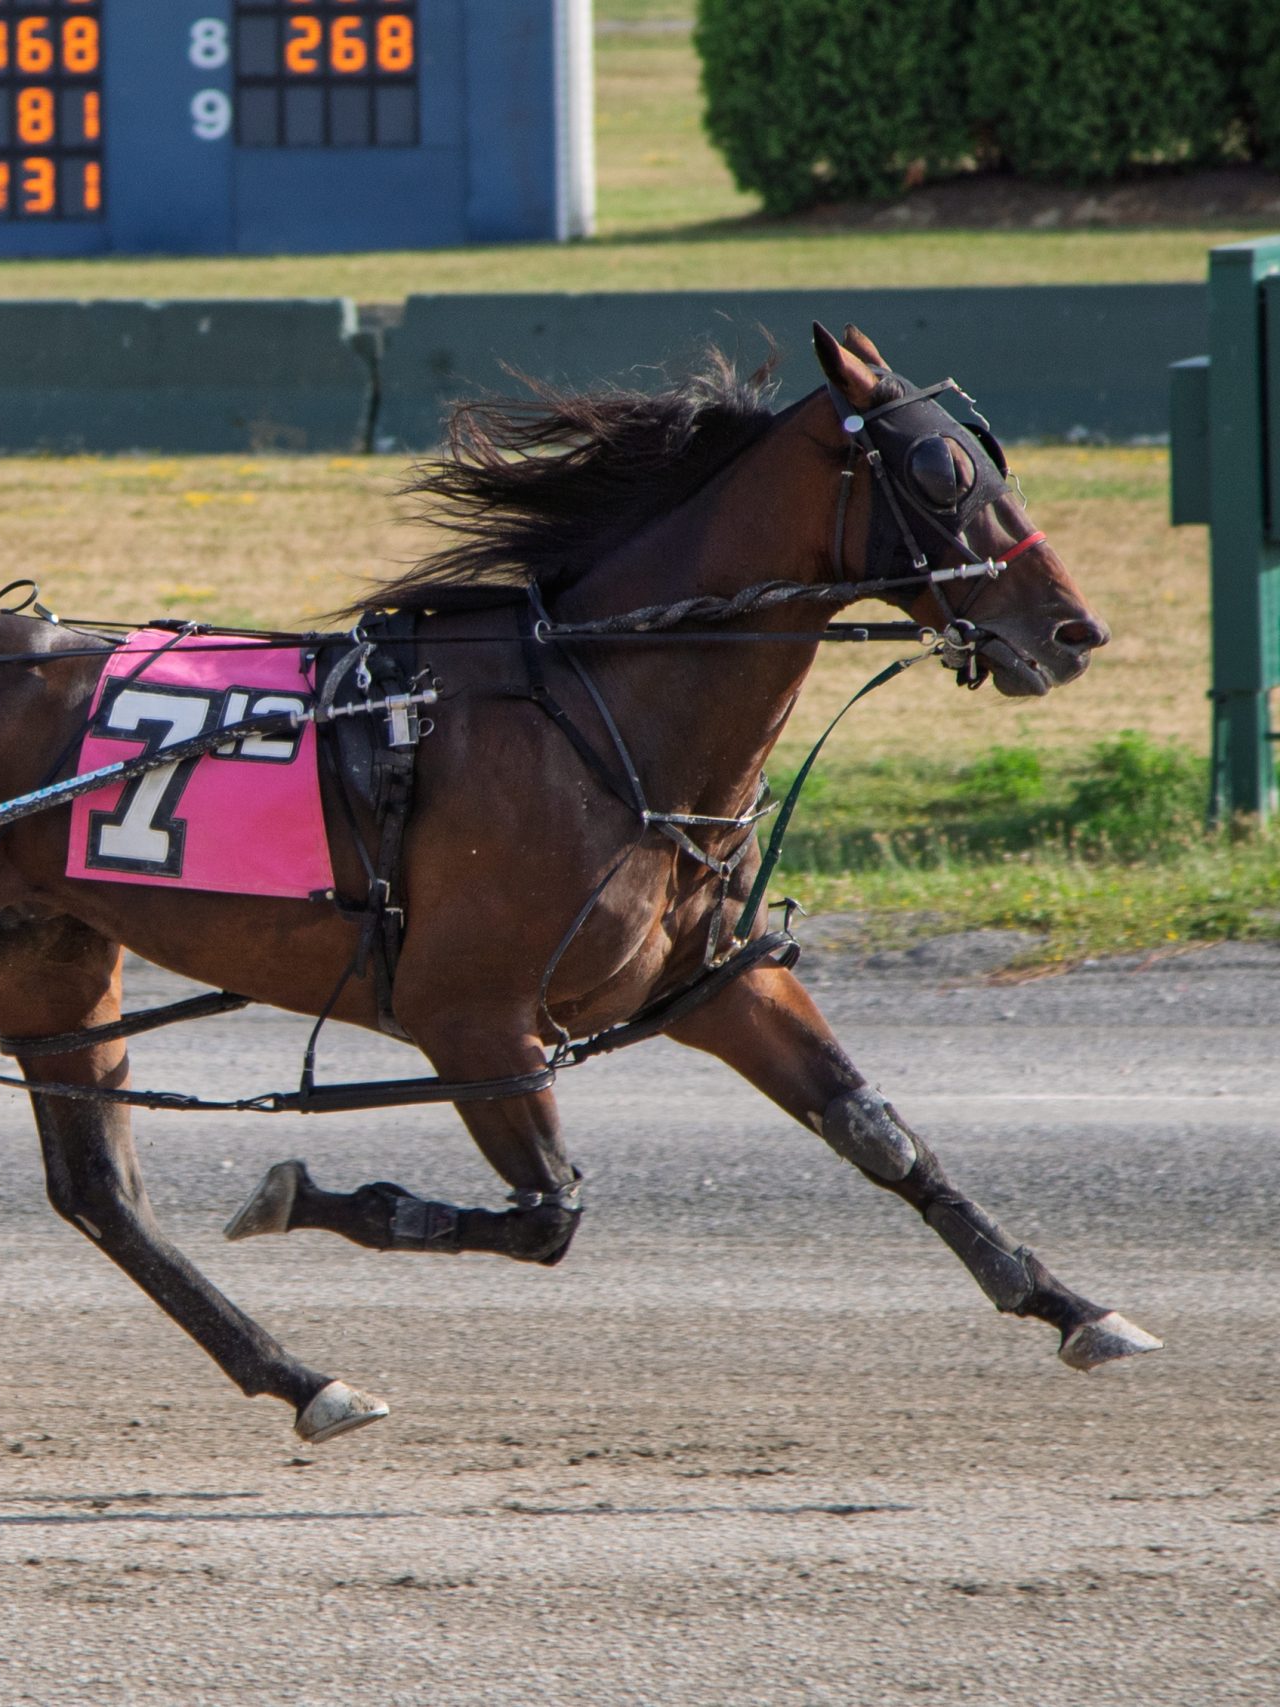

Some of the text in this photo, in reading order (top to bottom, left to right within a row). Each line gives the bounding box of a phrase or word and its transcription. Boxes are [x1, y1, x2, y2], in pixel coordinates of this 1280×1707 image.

[190, 18, 229, 69] 8
[285, 13, 414, 74] 268
[17, 86, 101, 145] 81
[190, 89, 231, 139] 9
[98, 689, 210, 864] 7
